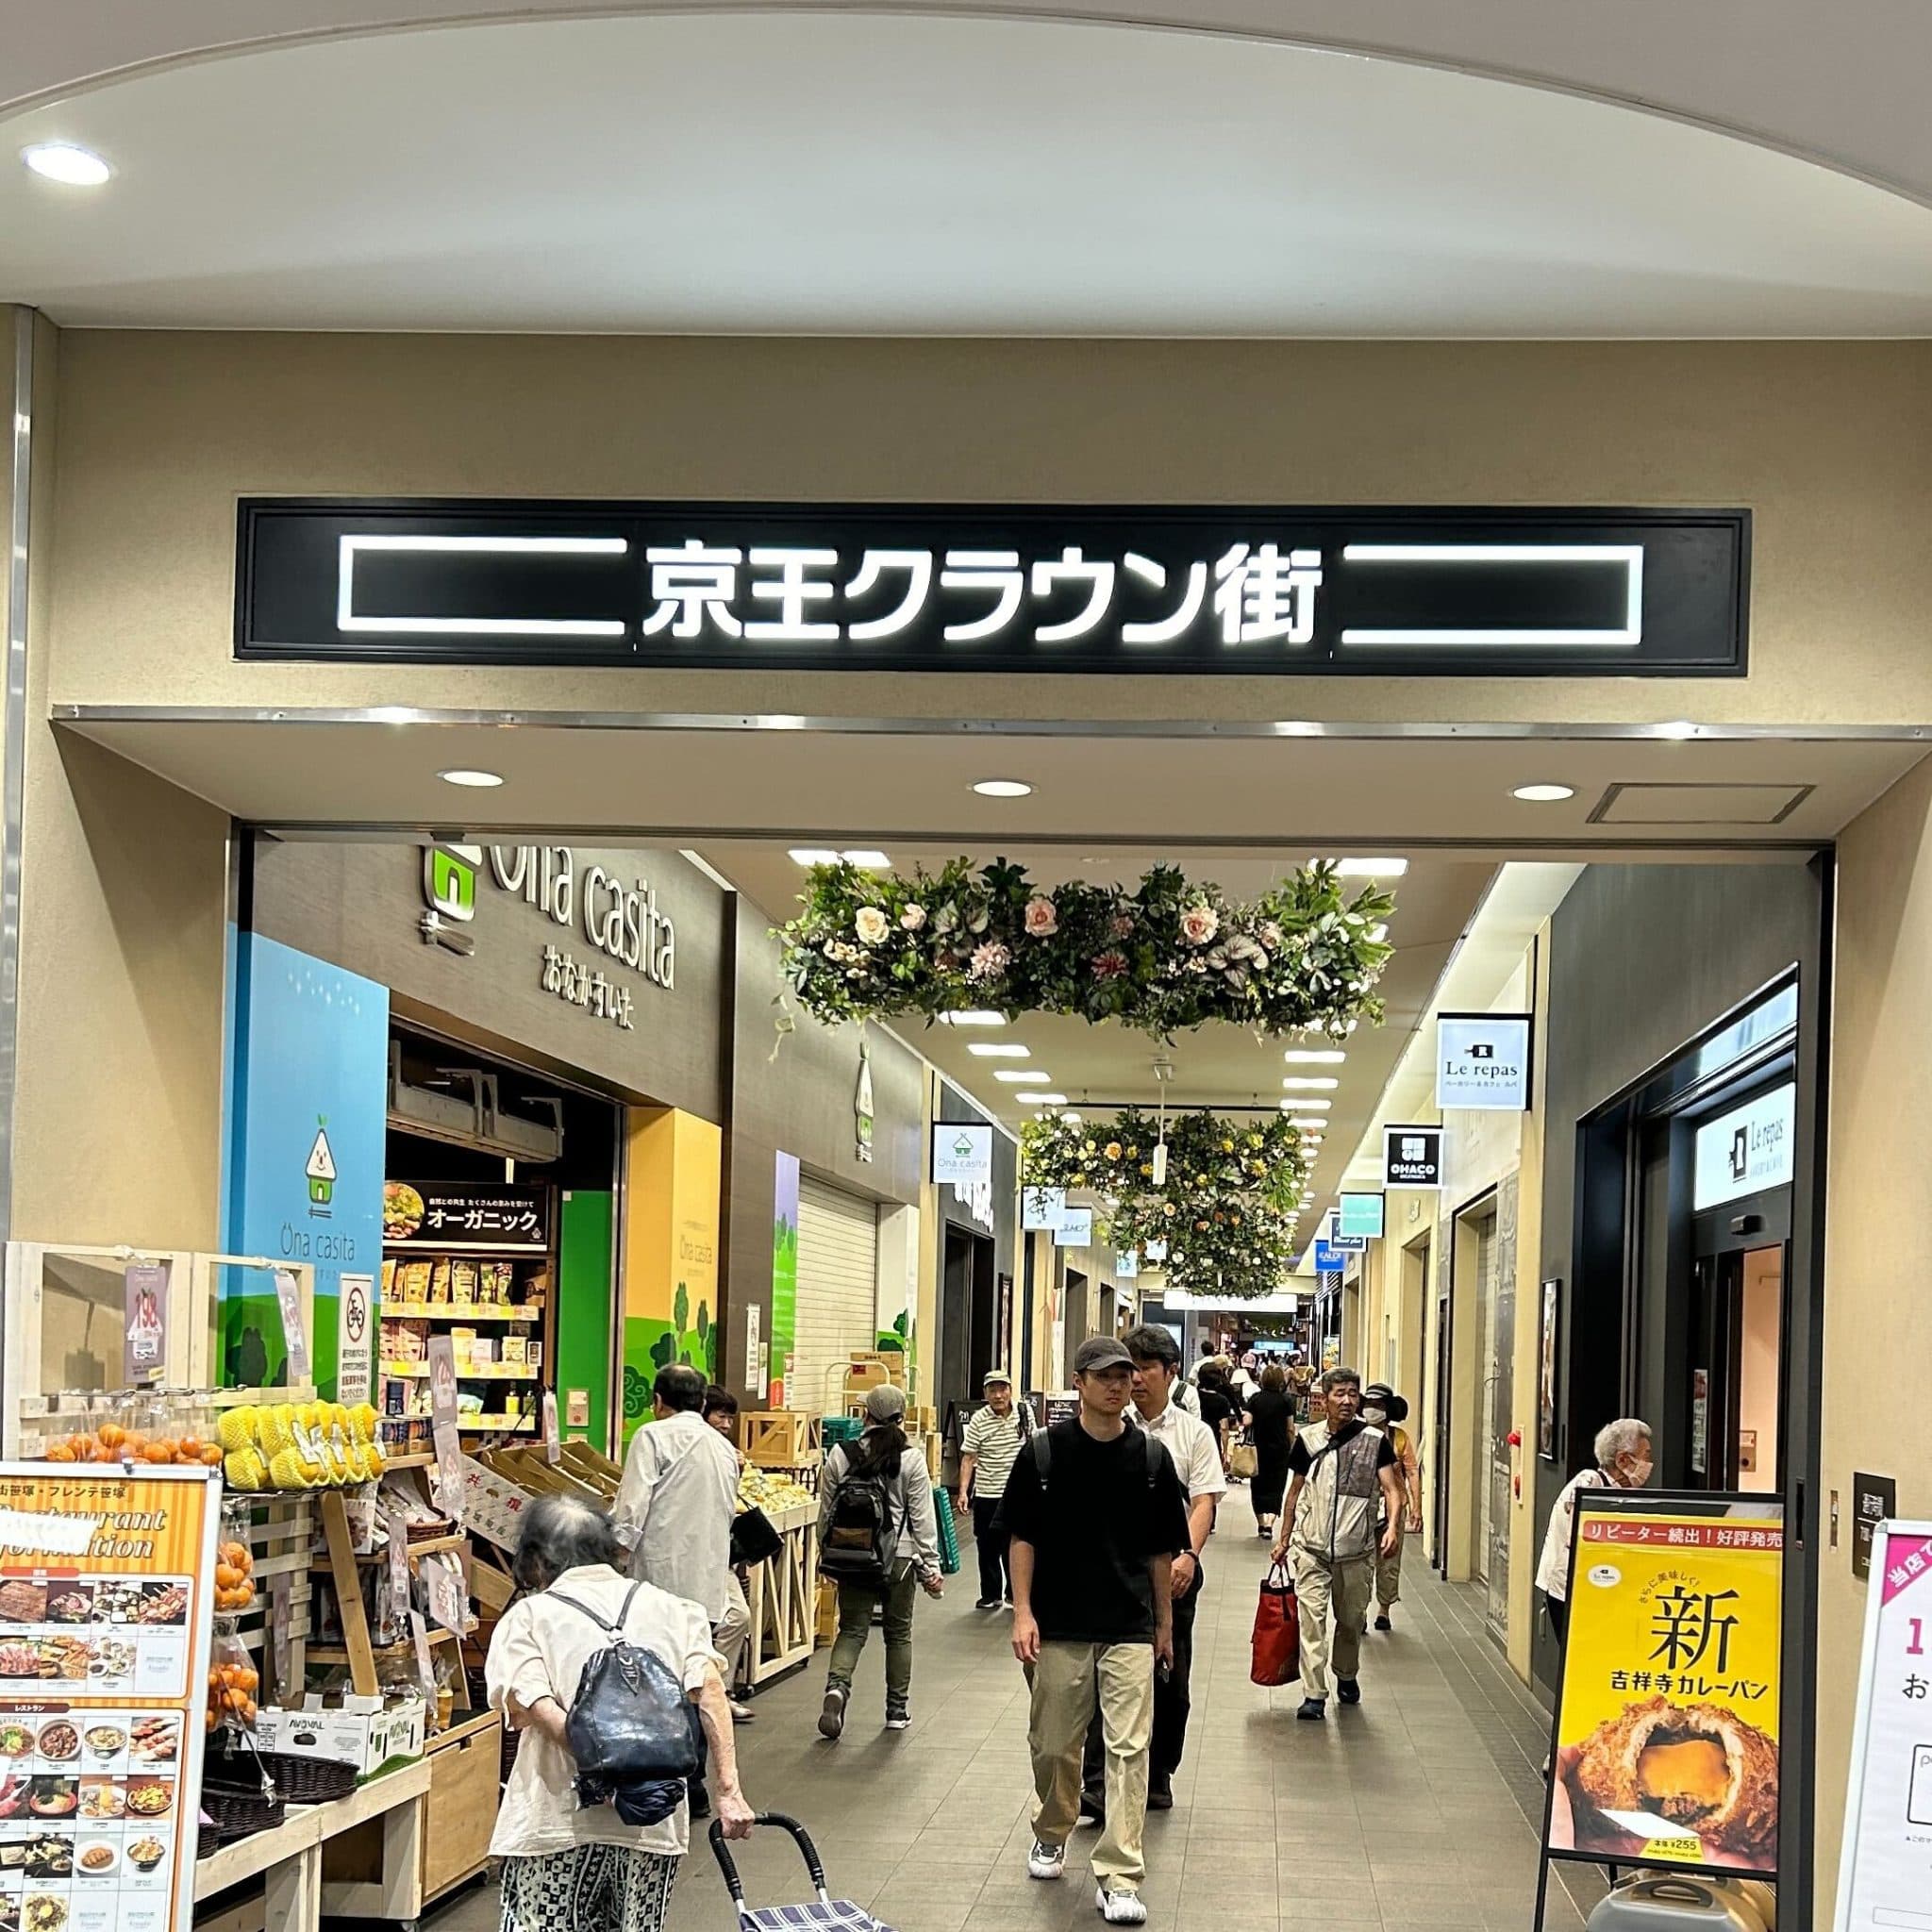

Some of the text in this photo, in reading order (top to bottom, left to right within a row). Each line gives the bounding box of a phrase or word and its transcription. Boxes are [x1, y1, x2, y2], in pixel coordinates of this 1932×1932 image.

[643, 540, 1323, 644] 京王クラウン街
[584, 866, 675, 990] casita
[543, 944, 633, 1030] おなかすいた
[1446, 1061, 1518, 1079] Le repas
[1751, 1118, 1783, 1152] Le repas
[959, 1159, 988, 1169] casita
[1391, 1163, 1436, 1175] OHACO
[427, 1208, 538, 1231] オーガニック
[316, 1232, 356, 1262] casita
[1648, 1585, 1740, 1674] 新
[1611, 1670, 1768, 1699] 吉祥寺カレーパン
